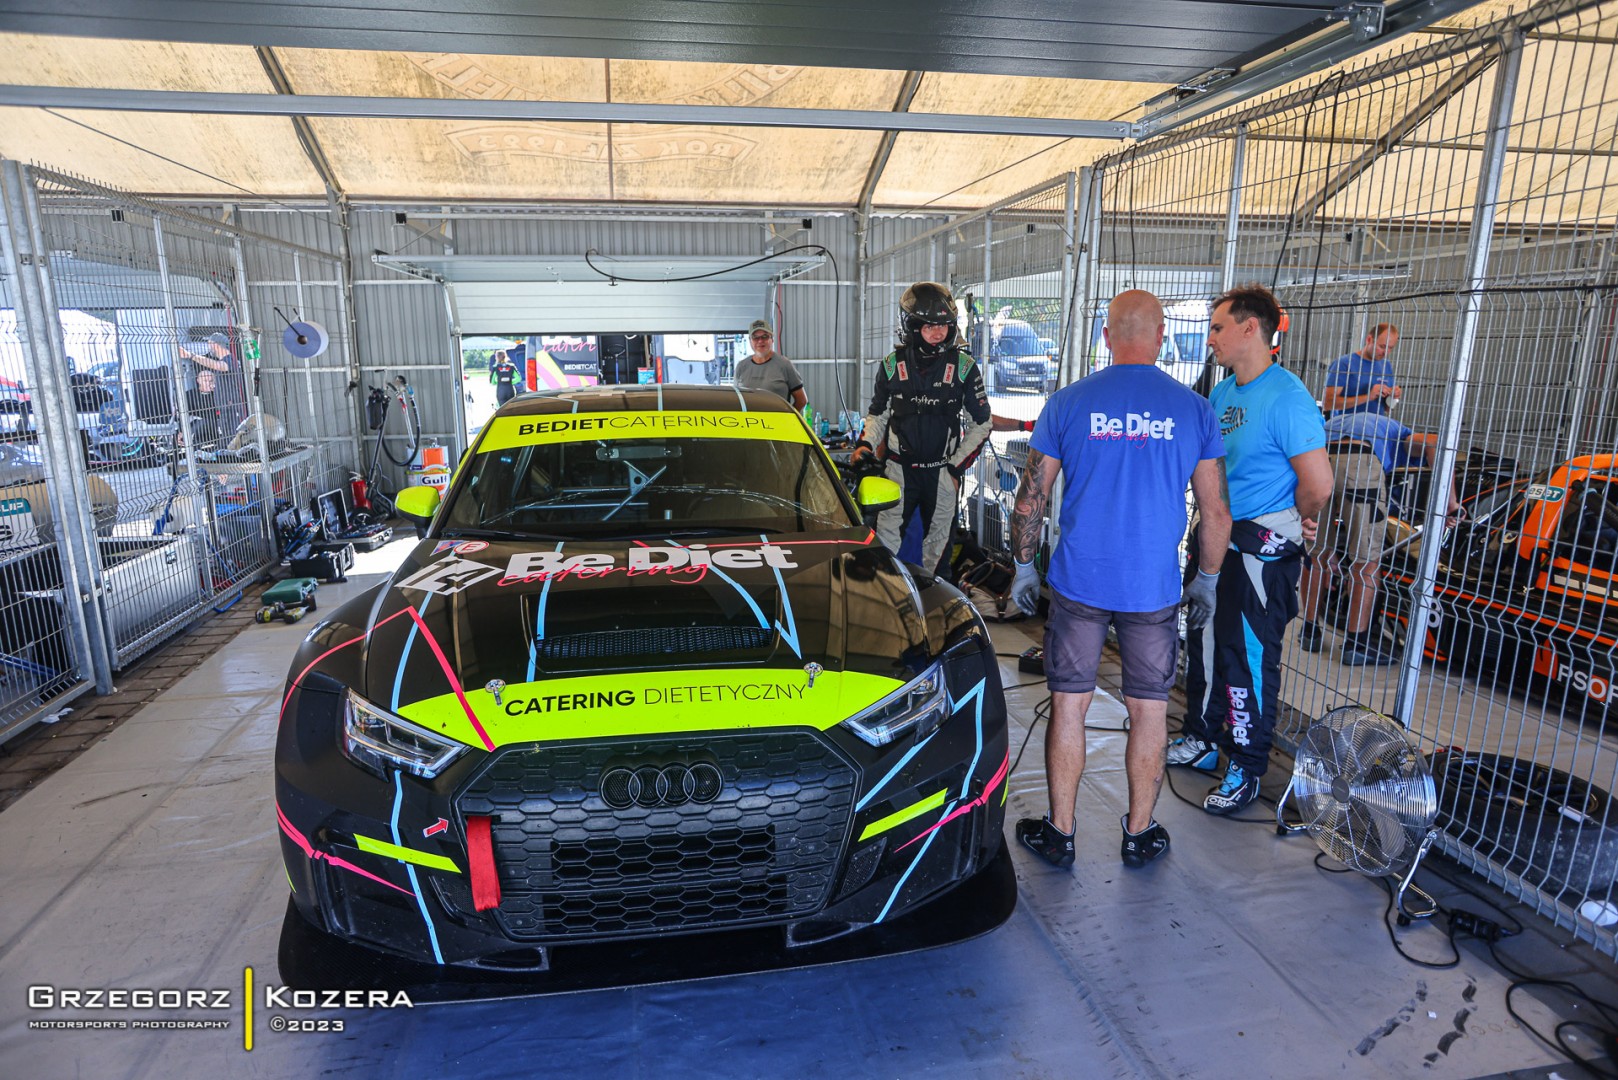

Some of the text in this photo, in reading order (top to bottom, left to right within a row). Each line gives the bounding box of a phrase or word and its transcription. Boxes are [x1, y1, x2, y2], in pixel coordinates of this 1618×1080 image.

[518, 415, 775, 436] BEDIETCATERING.PL
[1090, 411, 1175, 440] Be Diet
[421, 476, 448, 485] Gulf
[497, 562, 708, 585] catering
[504, 543, 798, 579] Be Diet
[504, 683, 806, 716] CATERING DIETETYCZNY
[1229, 686, 1248, 709] Be
[1231, 709, 1253, 746] Diet
